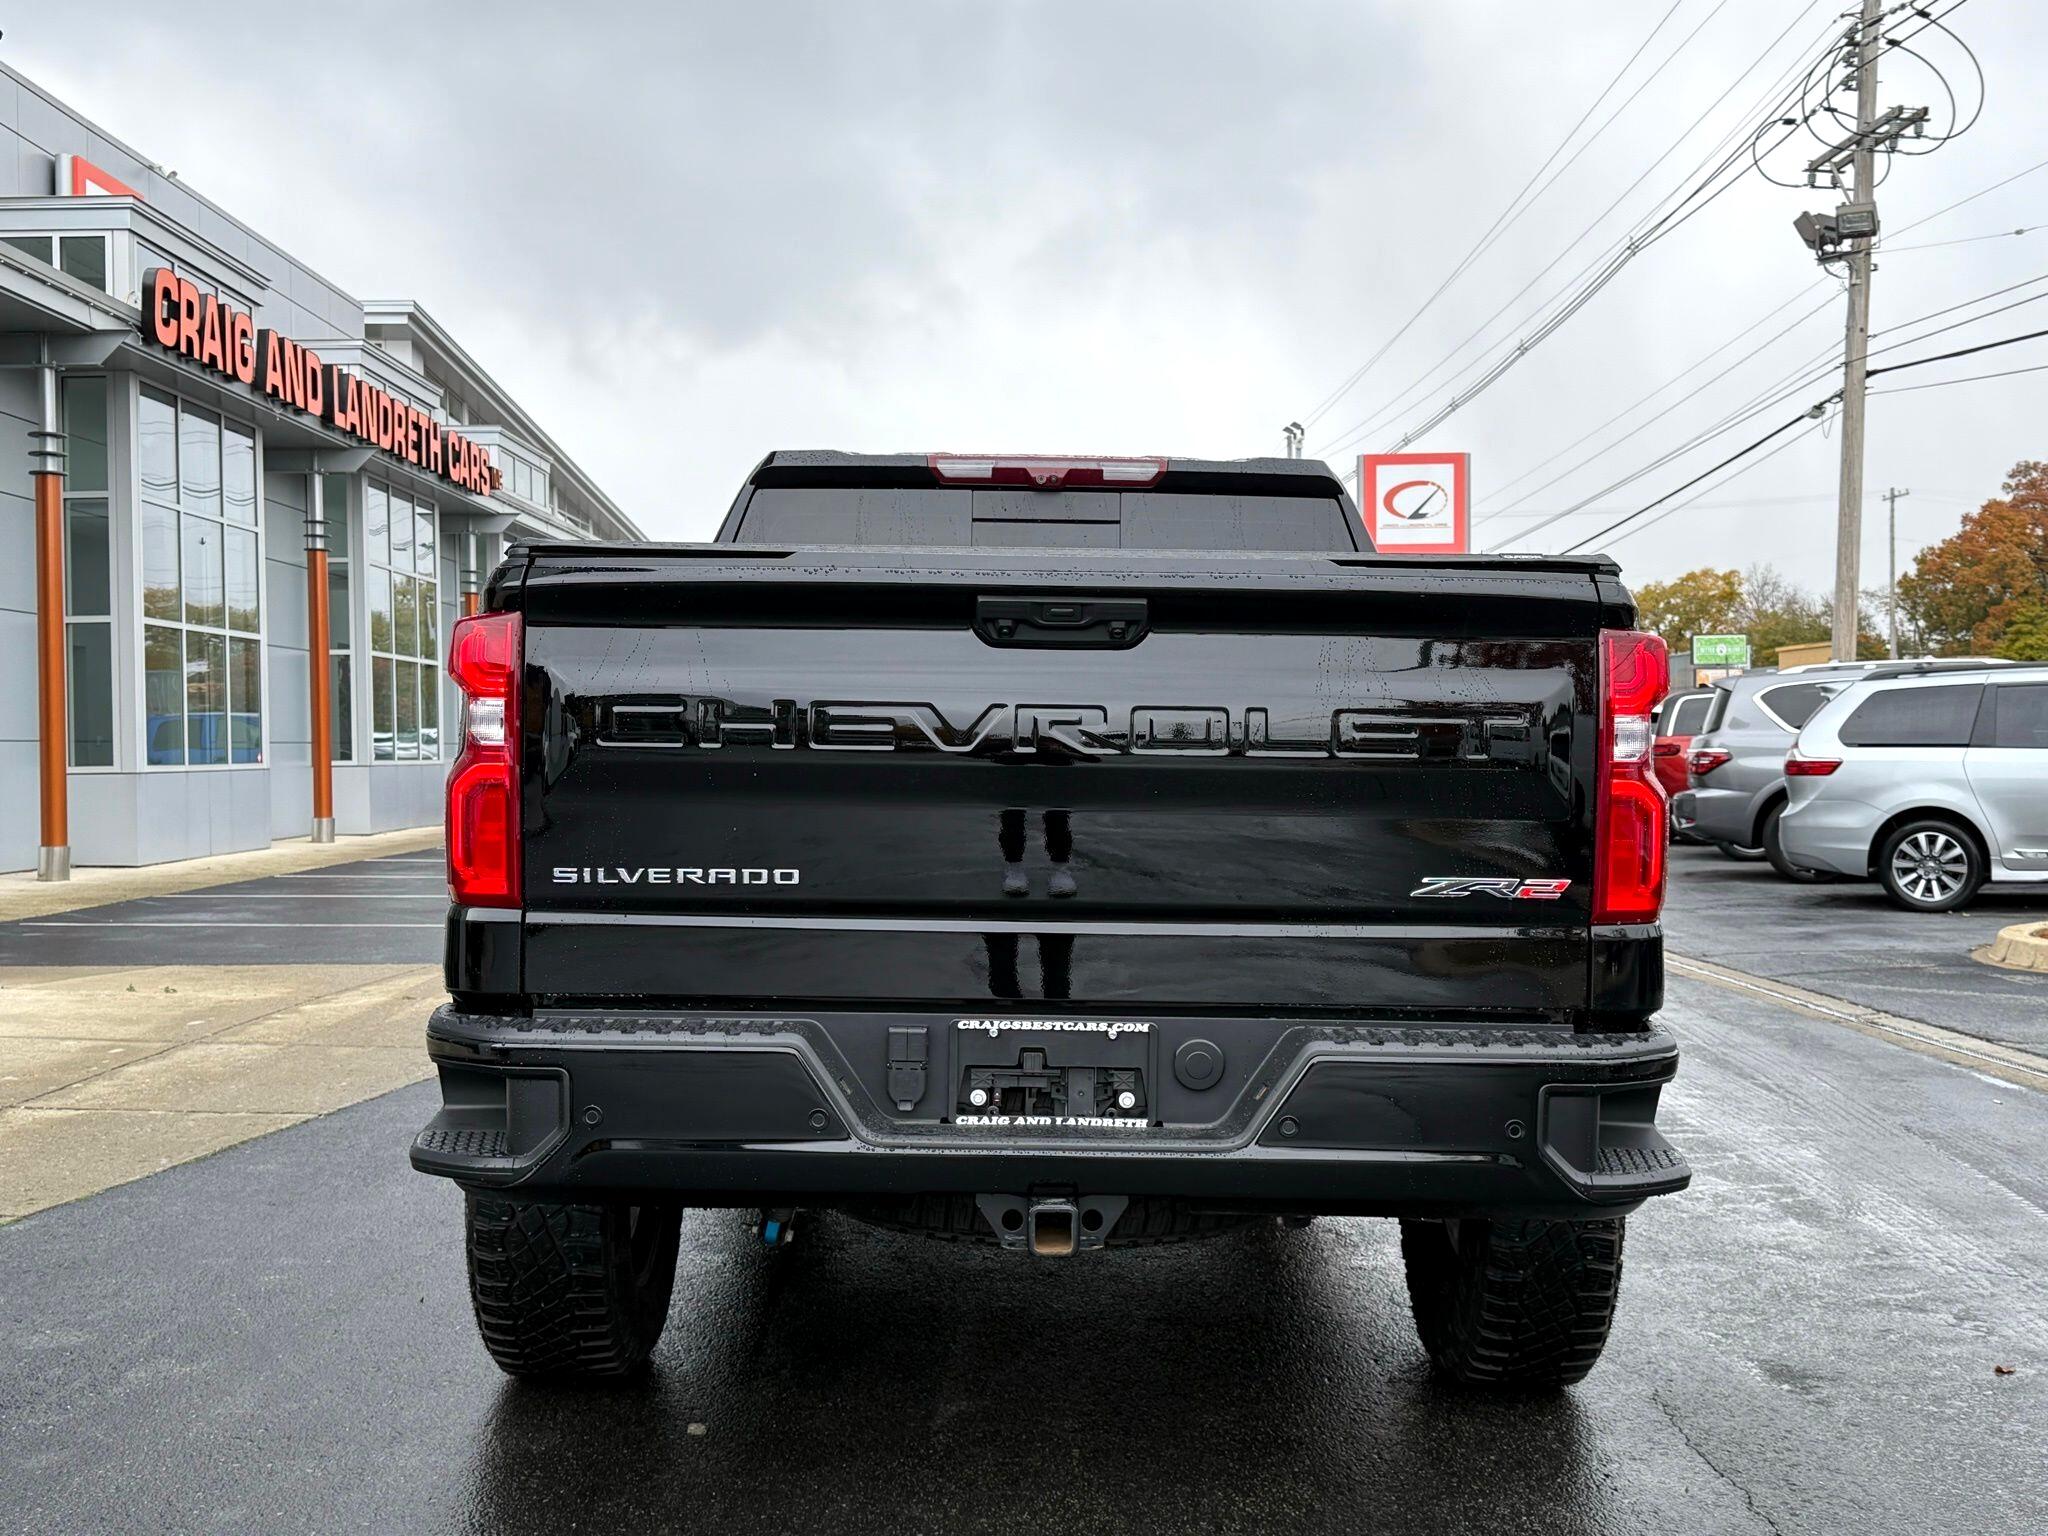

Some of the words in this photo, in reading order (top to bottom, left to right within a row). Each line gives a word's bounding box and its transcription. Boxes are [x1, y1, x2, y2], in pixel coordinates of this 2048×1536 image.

[147, 266, 255, 385] CRAIG
[262, 328, 324, 417] AND
[332, 364, 443, 476] LANDRETH
[447, 430, 491, 497] CARS
[595, 699, 1530, 760] CHEVROLET
[552, 867, 800, 885] SILVERADO
[1410, 877, 1572, 900] ZR2
[957, 1020, 1151, 1033] CRAIGSBESTCARS.COM
[955, 1115, 1011, 1126] CRAIG
[1013, 1116, 1053, 1126] AND
[1055, 1116, 1149, 1128] LANDRETH
